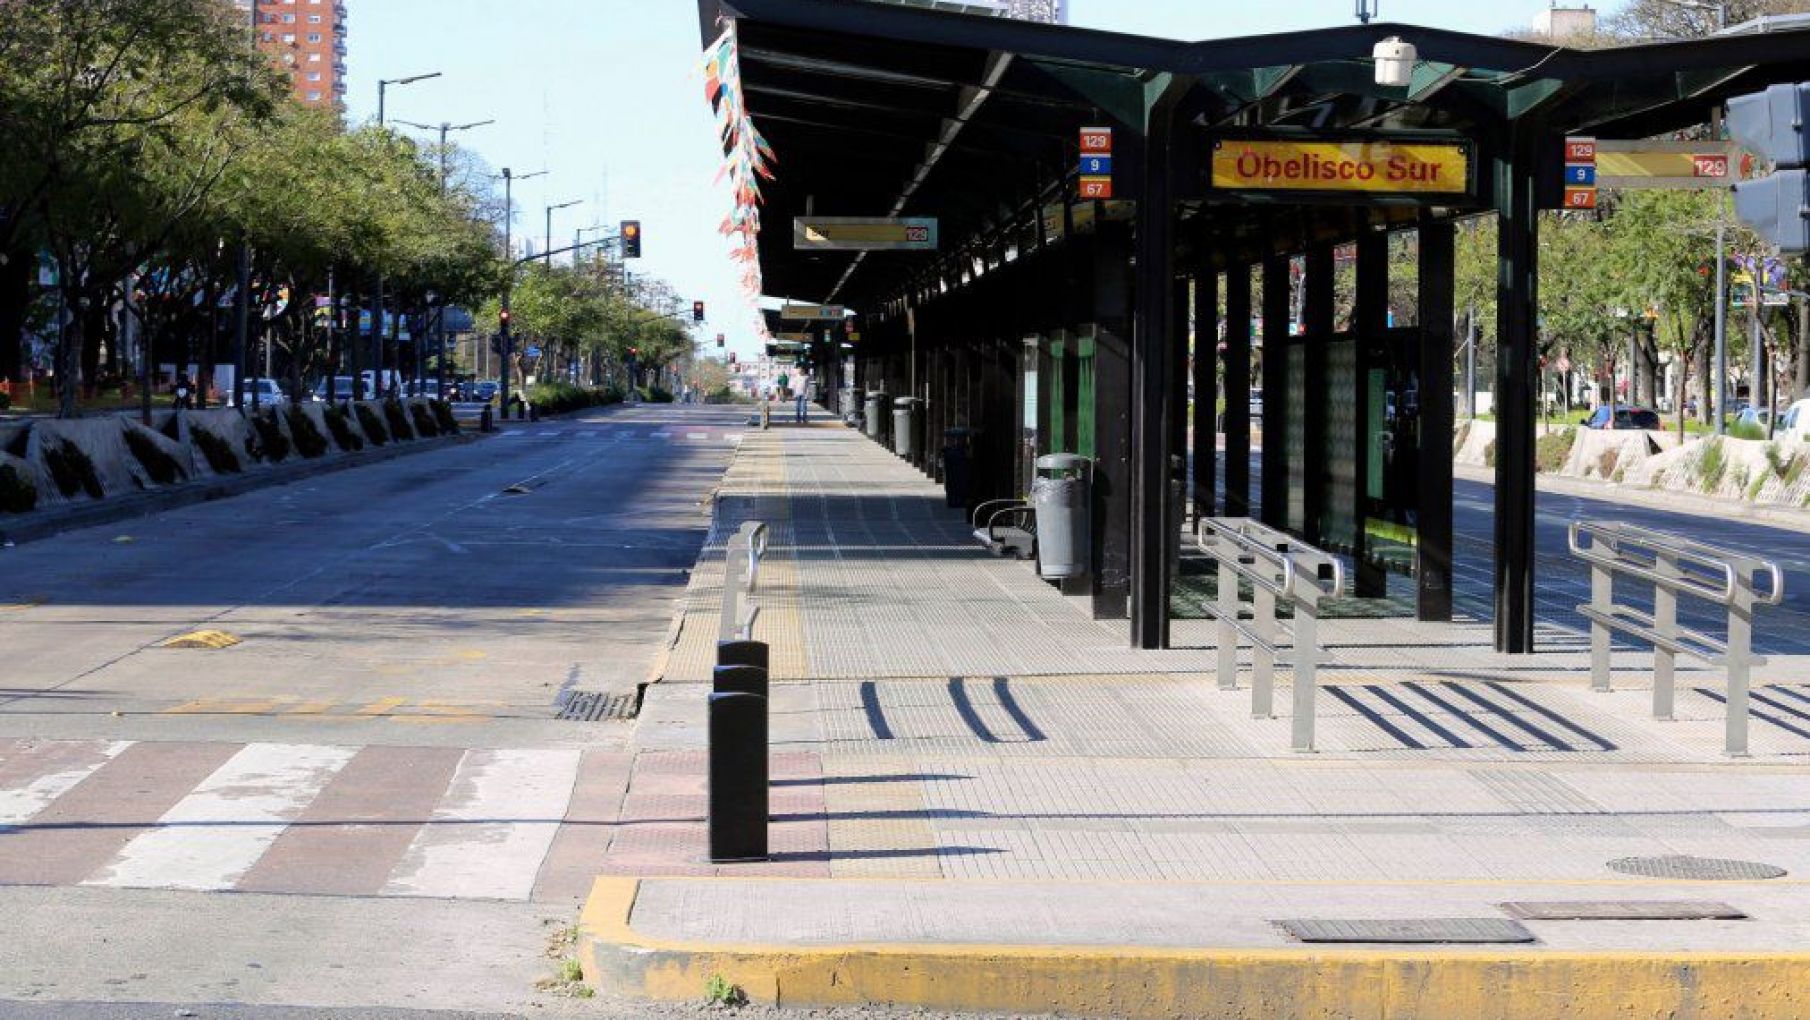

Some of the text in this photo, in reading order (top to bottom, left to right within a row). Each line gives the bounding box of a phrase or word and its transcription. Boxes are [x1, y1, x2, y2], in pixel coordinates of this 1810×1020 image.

[1083, 135, 1106, 148] 129
[1571, 144, 1592, 157] 129
[1090, 158, 1099, 171] 9
[1237, 153, 1442, 181] Obelisco Sur
[1695, 160, 1725, 176] 129
[1576, 169, 1586, 182] 9
[1087, 183, 1103, 196] 67
[1573, 192, 1589, 205] 67
